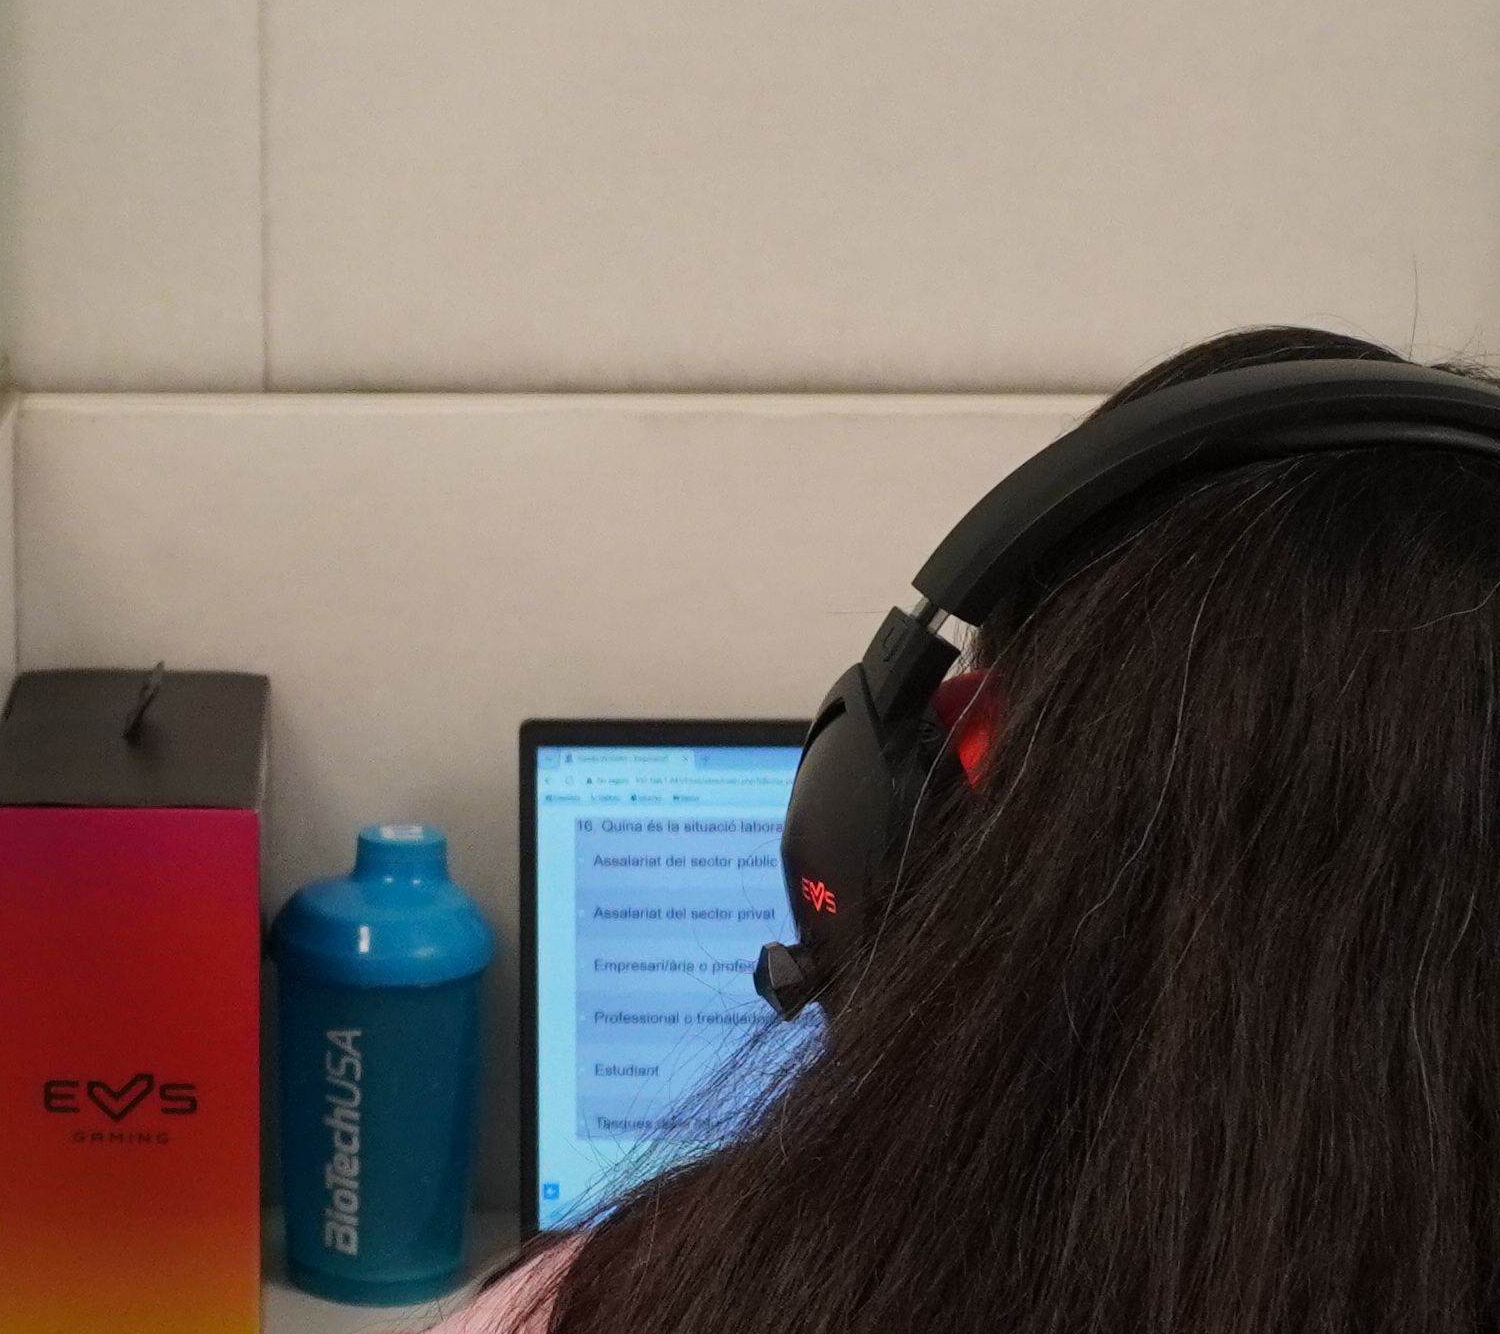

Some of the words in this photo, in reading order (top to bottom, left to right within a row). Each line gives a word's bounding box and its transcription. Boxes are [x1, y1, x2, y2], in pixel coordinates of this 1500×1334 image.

[602, 820, 642, 834] Quina
[646, 819, 664, 833] és
[667, 820, 680, 833] la
[683, 819, 737, 833] situació
[740, 820, 783, 833] labora
[594, 854, 662, 868] Assalariat
[666, 854, 686, 868] del
[691, 855, 732, 868] sector
[737, 853, 778, 870] públic
[594, 906, 662, 920] Assalariat
[666, 906, 686, 920] del
[691, 907, 732, 920] sector
[737, 906, 776, 923] privat
[699, 962, 708, 972] o
[712, 958, 754, 975] profes
[594, 1011, 679, 1024] Professional
[595, 1063, 660, 1077] Estudiant
[72, 1132, 169, 1145] GAMING
[323, 1028, 361, 1256] BioTechUSA
